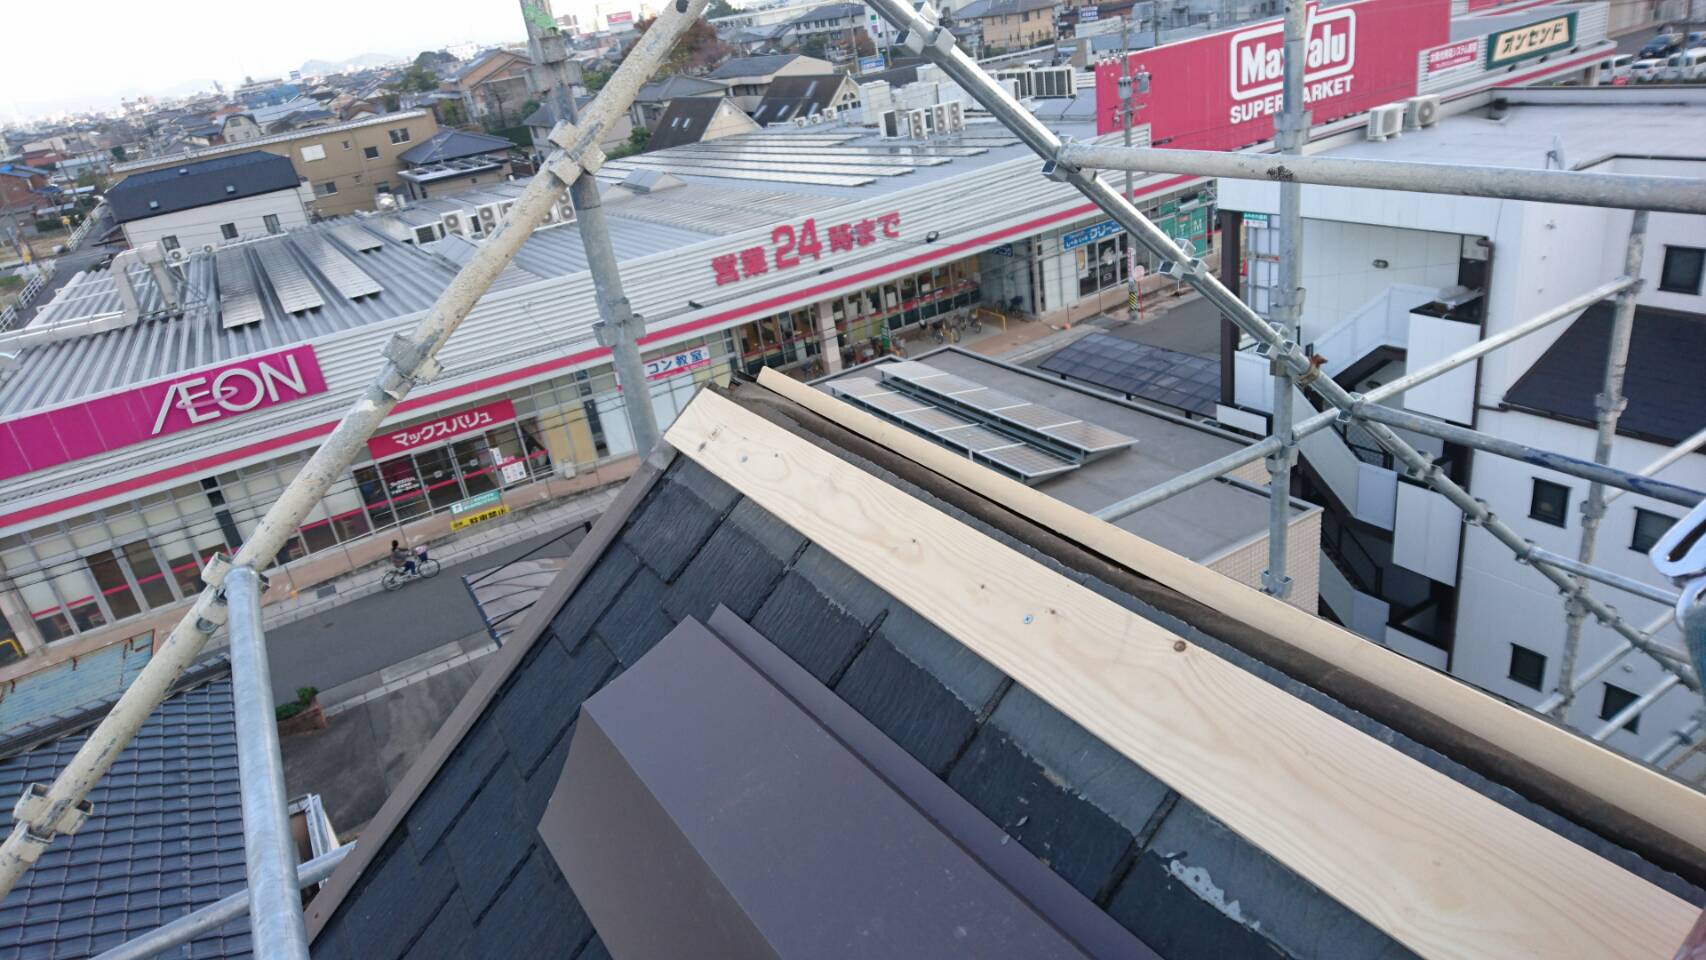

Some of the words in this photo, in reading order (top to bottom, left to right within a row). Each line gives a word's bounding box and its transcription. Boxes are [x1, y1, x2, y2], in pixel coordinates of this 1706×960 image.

[1241, 5, 1346, 86] Maalu
[1230, 74, 1354, 124] SUPERARKET
[391, 411, 493, 446] マックスバリュ
